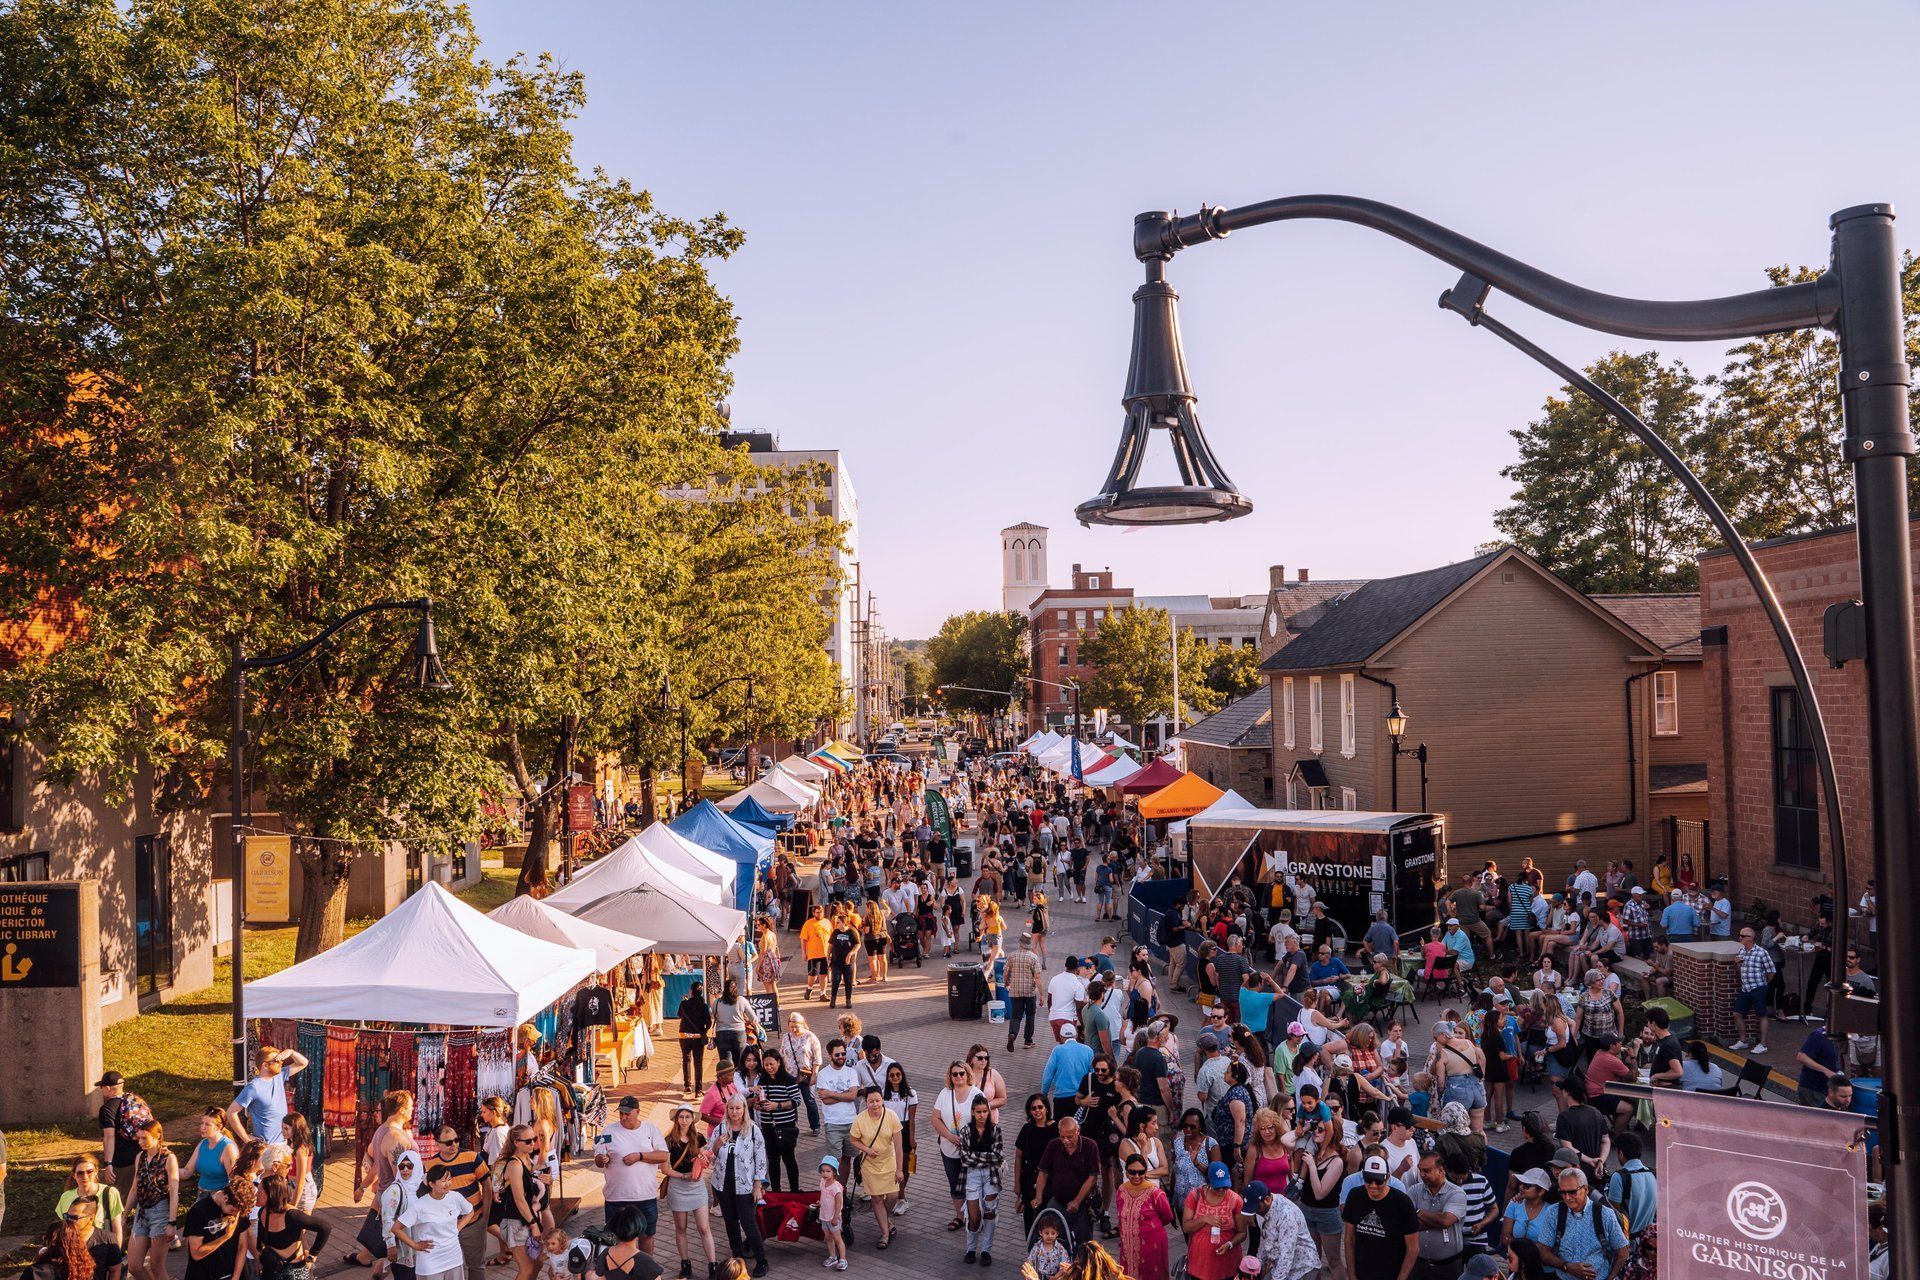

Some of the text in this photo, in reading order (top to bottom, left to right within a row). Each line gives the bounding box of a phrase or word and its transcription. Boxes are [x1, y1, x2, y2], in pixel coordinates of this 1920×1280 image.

[1405, 853, 1435, 868] GRAYSTONE
[1288, 861, 1372, 879] GRAYSTONE
[0, 906, 43, 916] IQUE de
[0, 918, 45, 928] ERICTON
[0, 930, 57, 940] IC LIBRARY
[1676, 1228, 1847, 1269] QUARTIER HISTORIQUE DE LA
[1692, 1243, 1828, 1280] GARNISON
